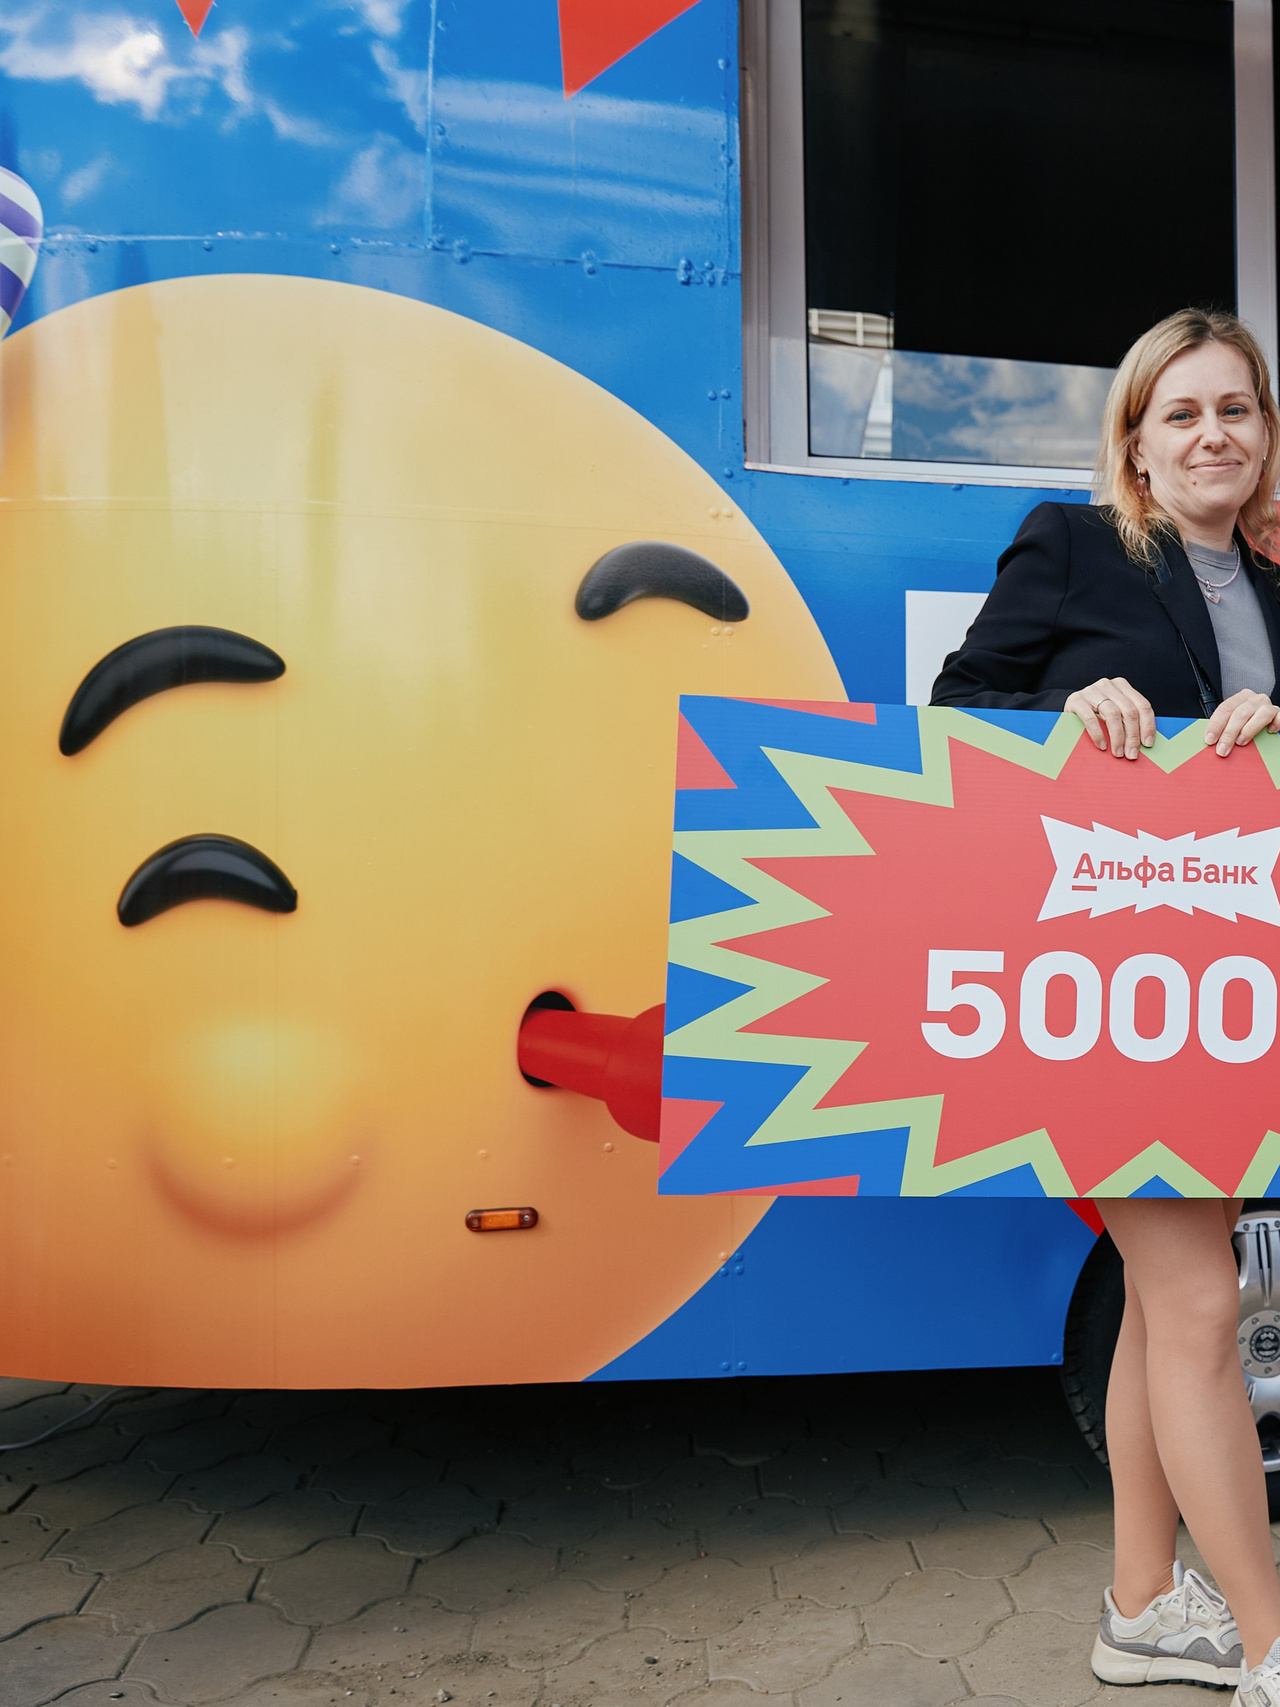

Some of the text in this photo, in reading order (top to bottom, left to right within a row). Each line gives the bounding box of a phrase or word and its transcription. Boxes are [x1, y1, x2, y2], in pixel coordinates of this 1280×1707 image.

[1072, 852, 1259, 891] Альфа Банк
[920, 949, 1278, 1064] 5000
